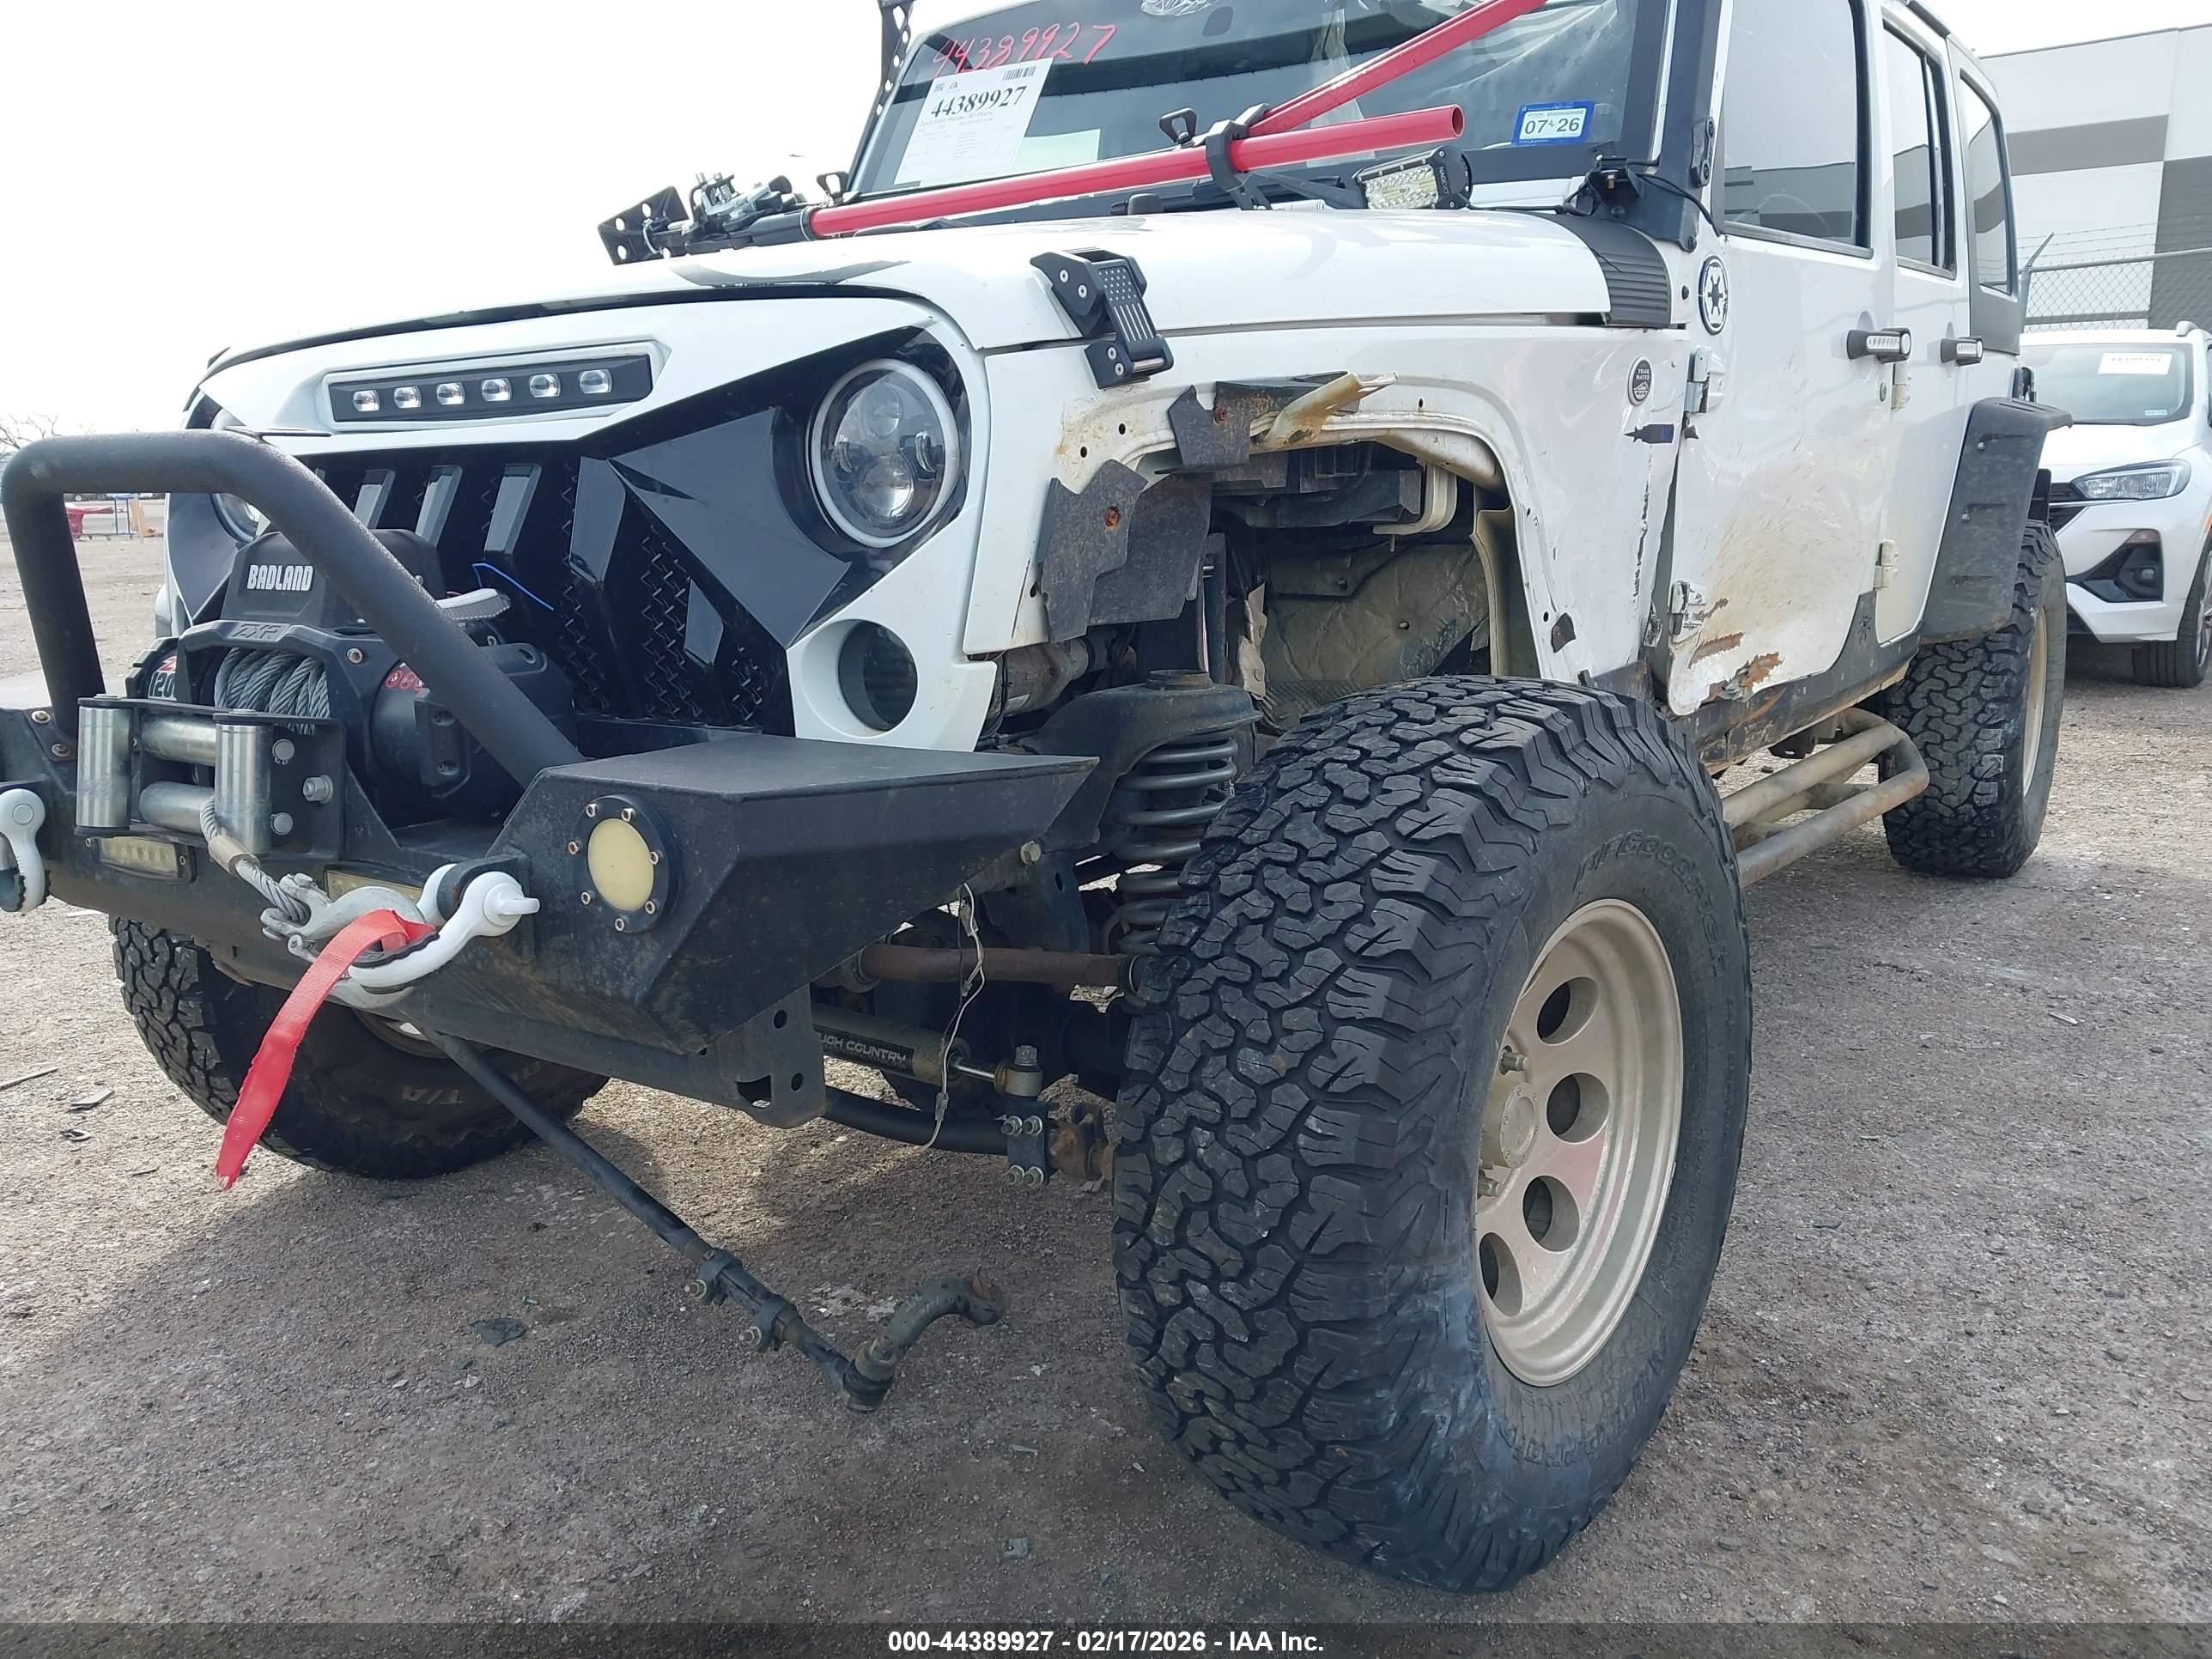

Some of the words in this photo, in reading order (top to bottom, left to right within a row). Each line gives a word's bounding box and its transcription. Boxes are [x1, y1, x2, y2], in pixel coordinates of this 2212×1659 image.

[933, 22, 1116, 78] 44389927
[931, 86, 1027, 118] 44389927
[1525, 119, 1548, 135] 07
[1557, 117, 1581, 132] 26
[246, 564, 313, 592] BADLAND
[846, 1041, 907, 1064] COUNTRY
